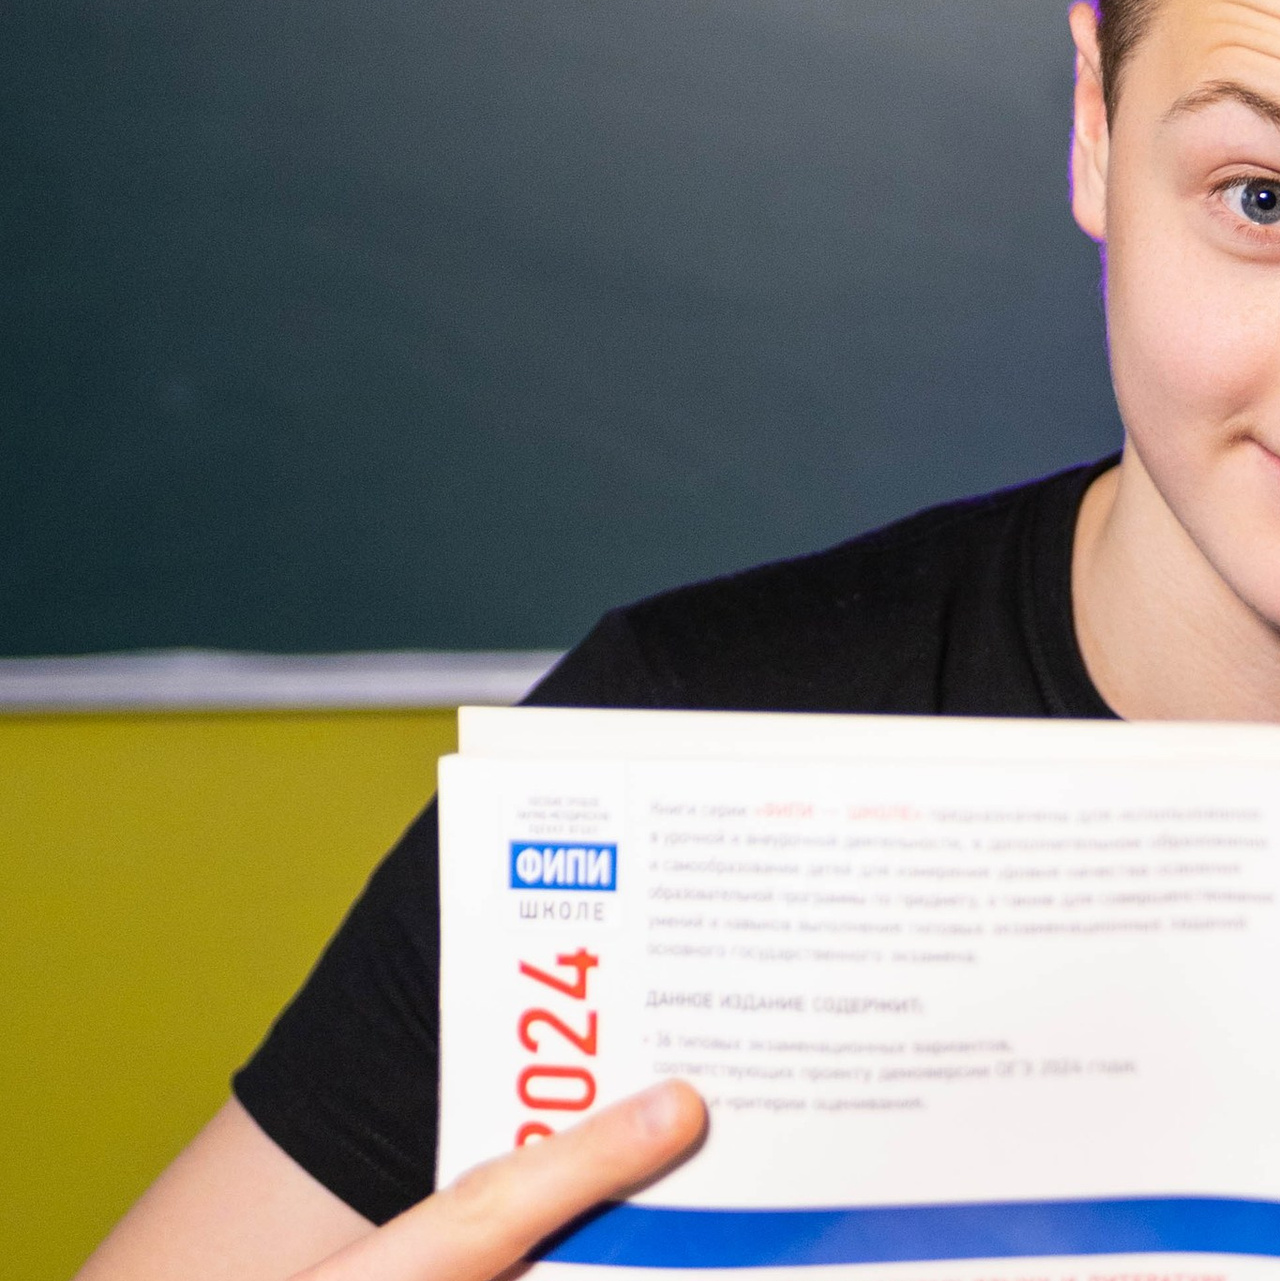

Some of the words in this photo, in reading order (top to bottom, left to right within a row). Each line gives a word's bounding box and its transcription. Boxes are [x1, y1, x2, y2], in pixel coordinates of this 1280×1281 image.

[514, 847, 610, 886] ФИПИ
[518, 900, 606, 921] ШКОЛЕ
[646, 989, 712, 1010] ДАННОЕ
[721, 992, 805, 1012] ИЗДАНИЕ
